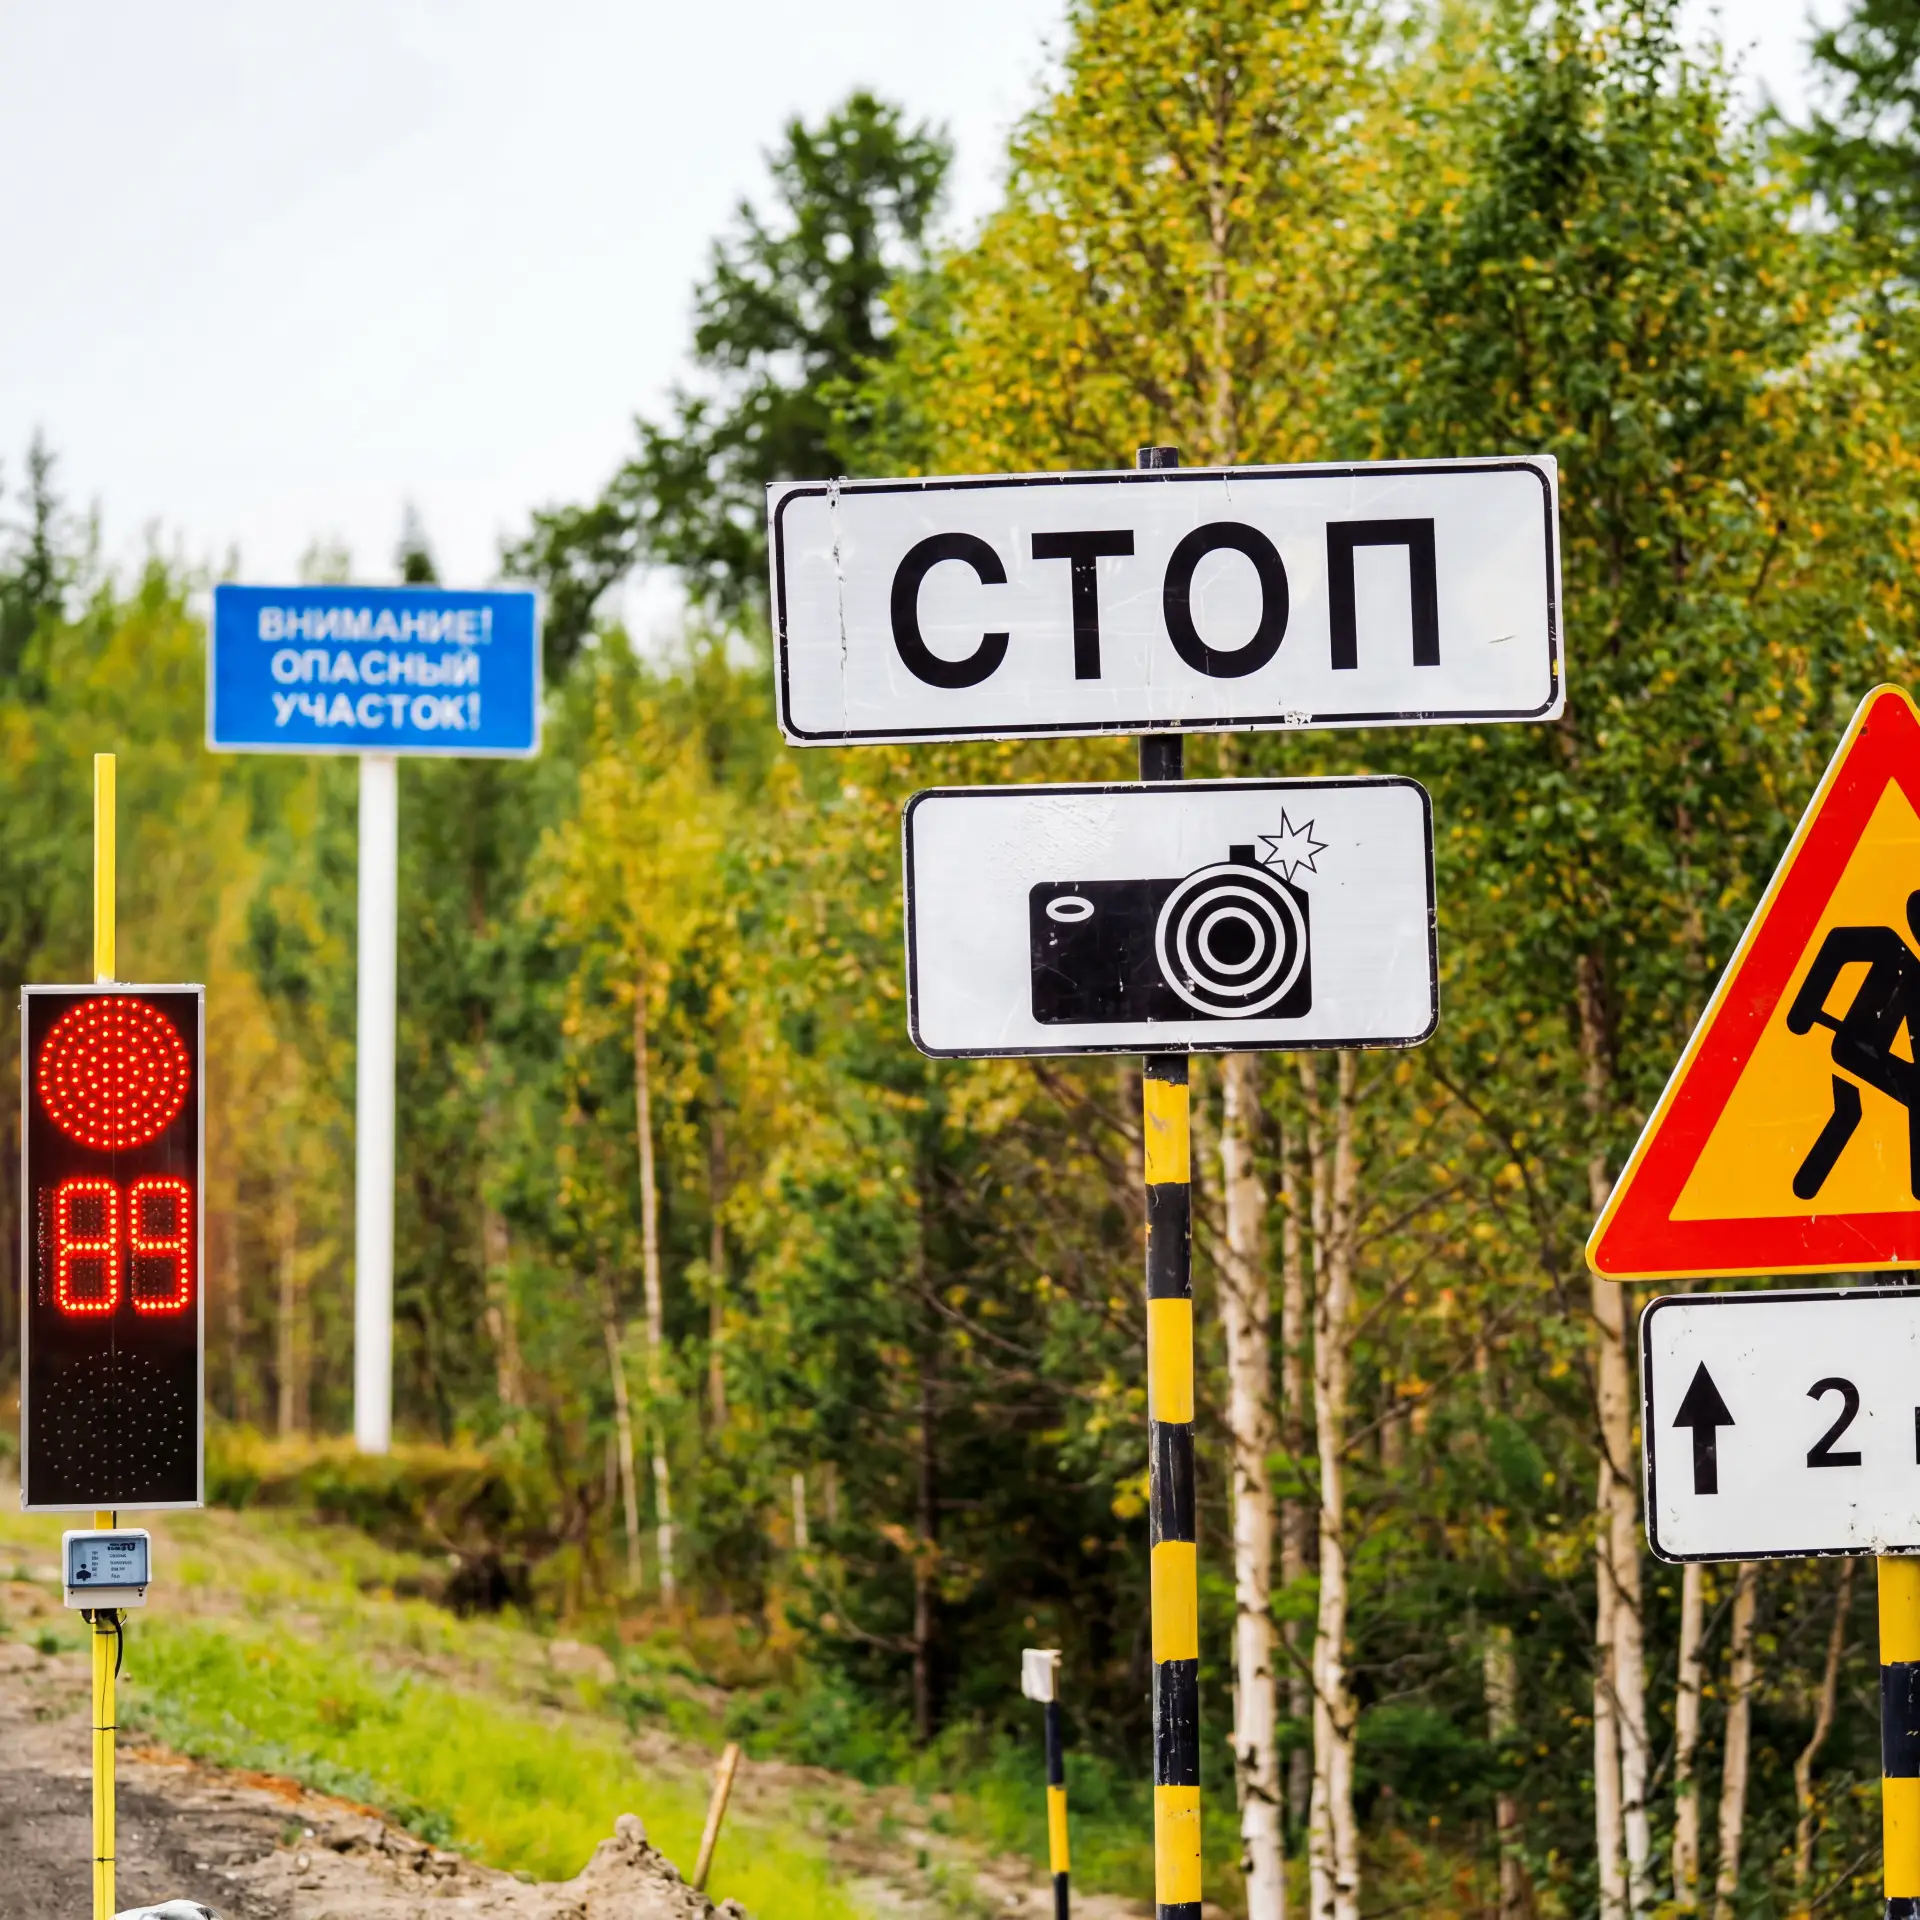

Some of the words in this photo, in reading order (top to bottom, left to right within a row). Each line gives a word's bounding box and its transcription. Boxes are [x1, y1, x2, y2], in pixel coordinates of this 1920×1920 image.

[259, 607, 492, 644] ВНИМАНИЕ!
[891, 518, 1440, 688] СТОП
[271, 647, 480, 686] ОПАСНЫЙ
[272, 692, 480, 730] УЧАСТОК!
[57, 1178, 189, 1312] 89
[1806, 1377, 1862, 1468] 2
